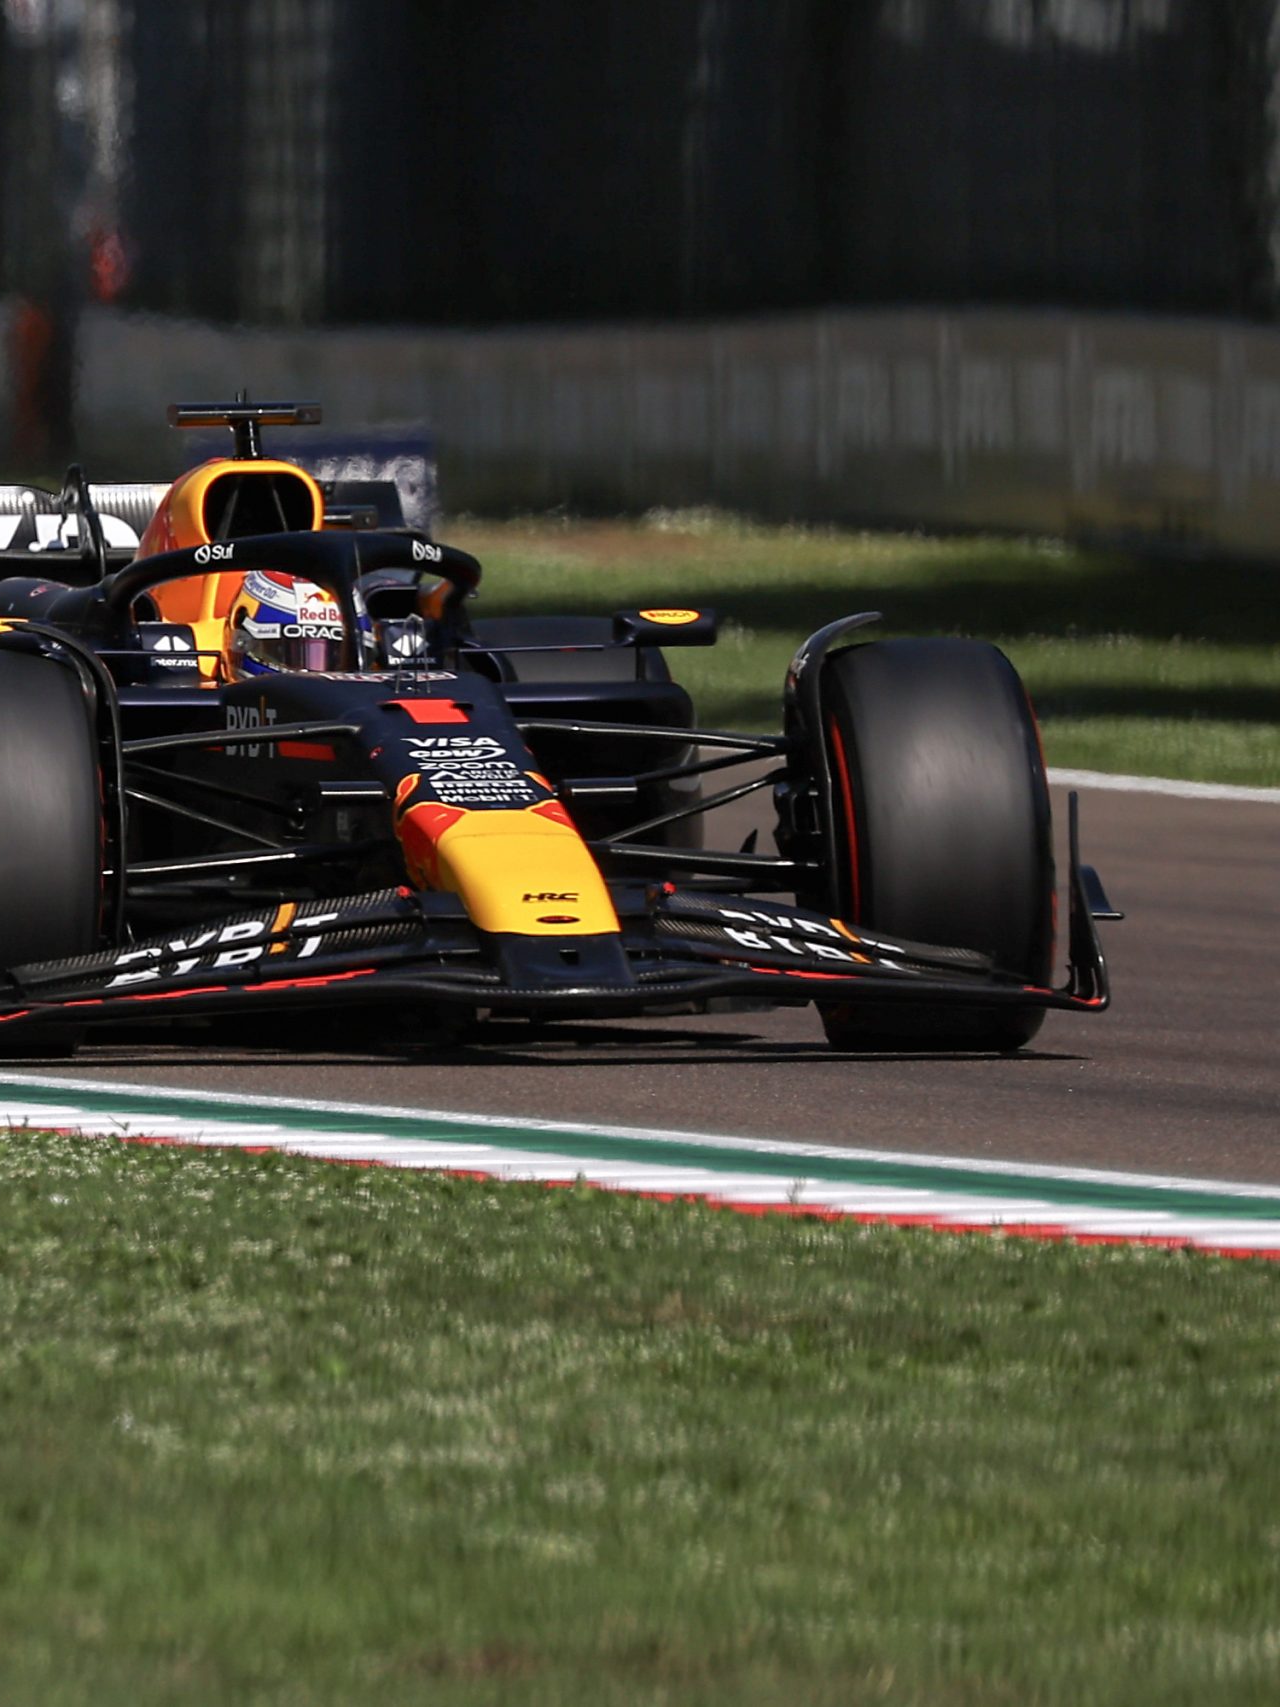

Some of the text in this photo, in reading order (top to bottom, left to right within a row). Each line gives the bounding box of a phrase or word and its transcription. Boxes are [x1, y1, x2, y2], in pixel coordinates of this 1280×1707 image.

[212, 544, 234, 560] Sui
[300, 608, 326, 621] Red
[400, 737, 500, 747] VISA
[408, 748, 488, 759] CDW
[418, 761, 517, 770] zoom
[439, 794, 511, 803] Mobil
[522, 892, 579, 903] HRC
